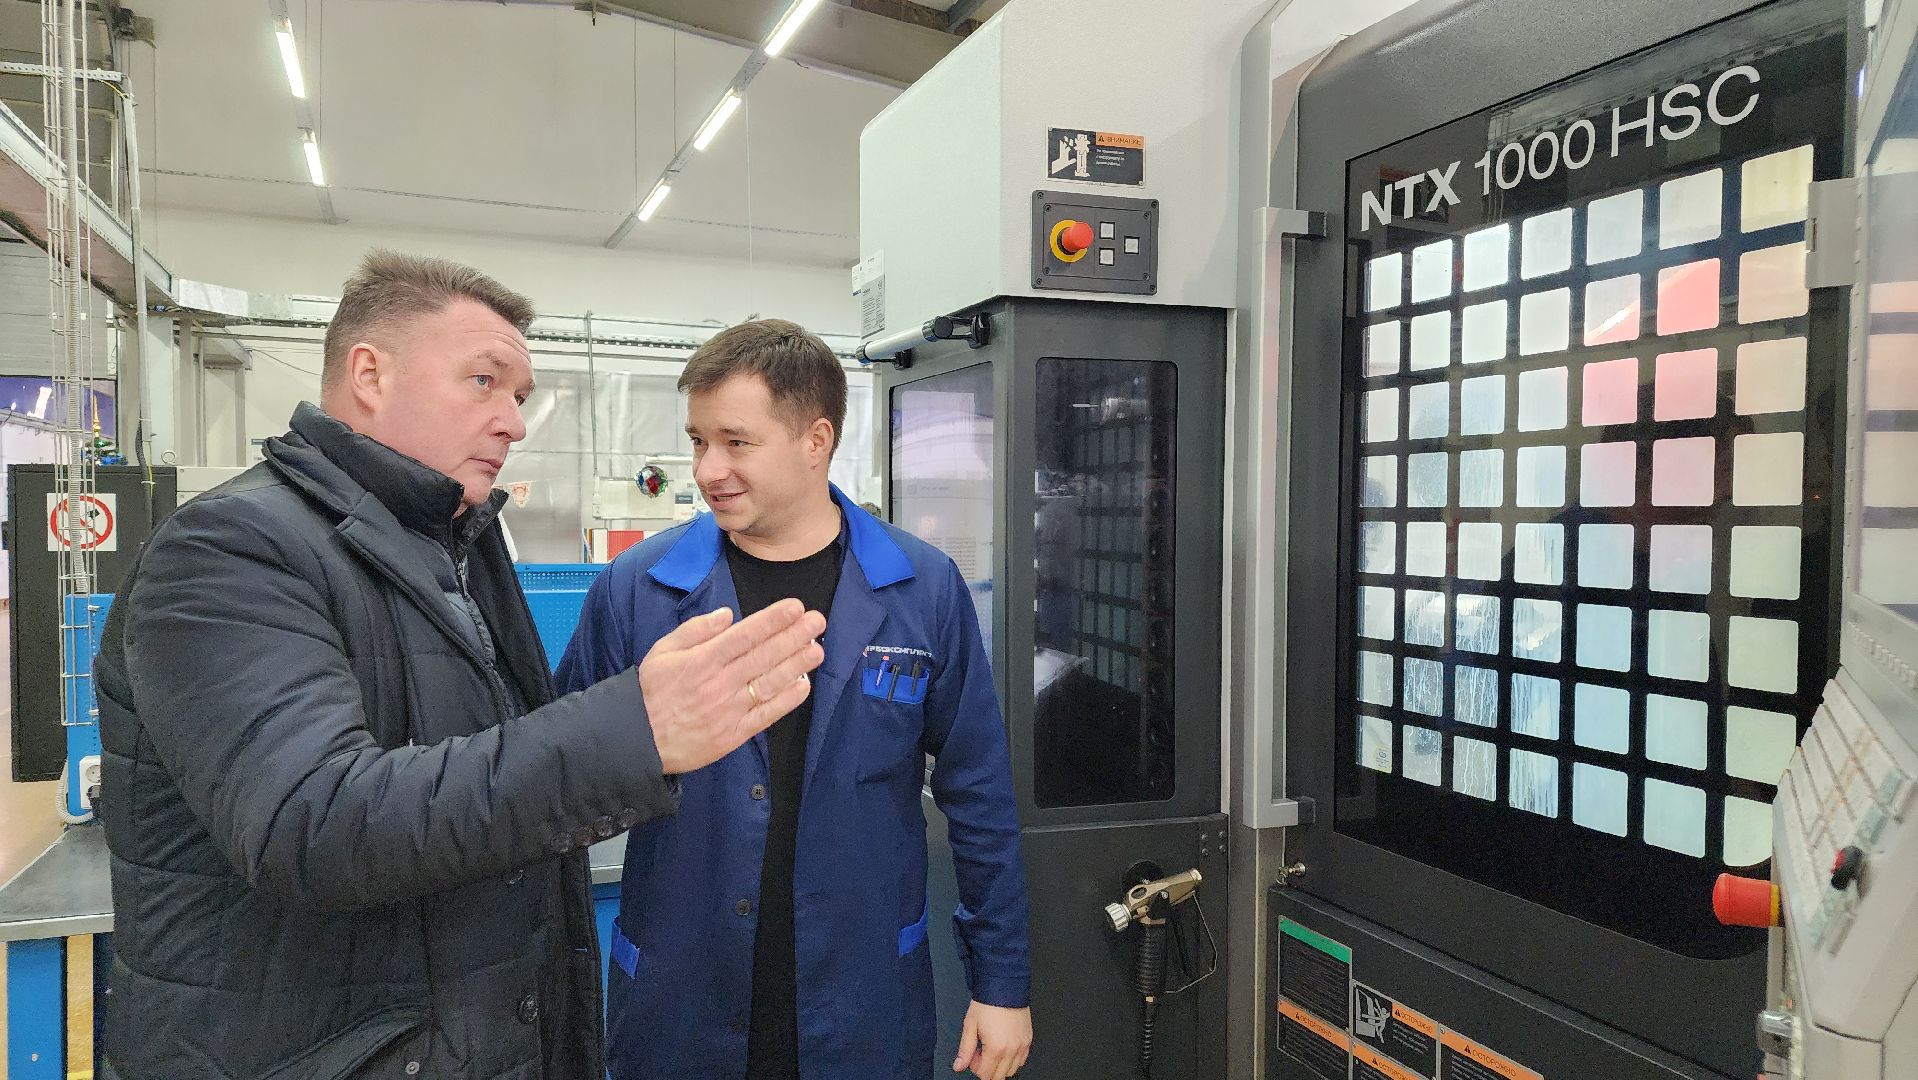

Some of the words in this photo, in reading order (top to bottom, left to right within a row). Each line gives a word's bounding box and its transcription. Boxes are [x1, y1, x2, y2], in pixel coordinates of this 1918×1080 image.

[1361, 161, 1461, 231] NTX
[1474, 120, 1596, 196] 1000
[1610, 65, 1761, 158] HSC
[1400, 1011, 1433, 1034] ОСТОРОЖНО
[1472, 1049, 1517, 1077] ОСТОРОЖНО
